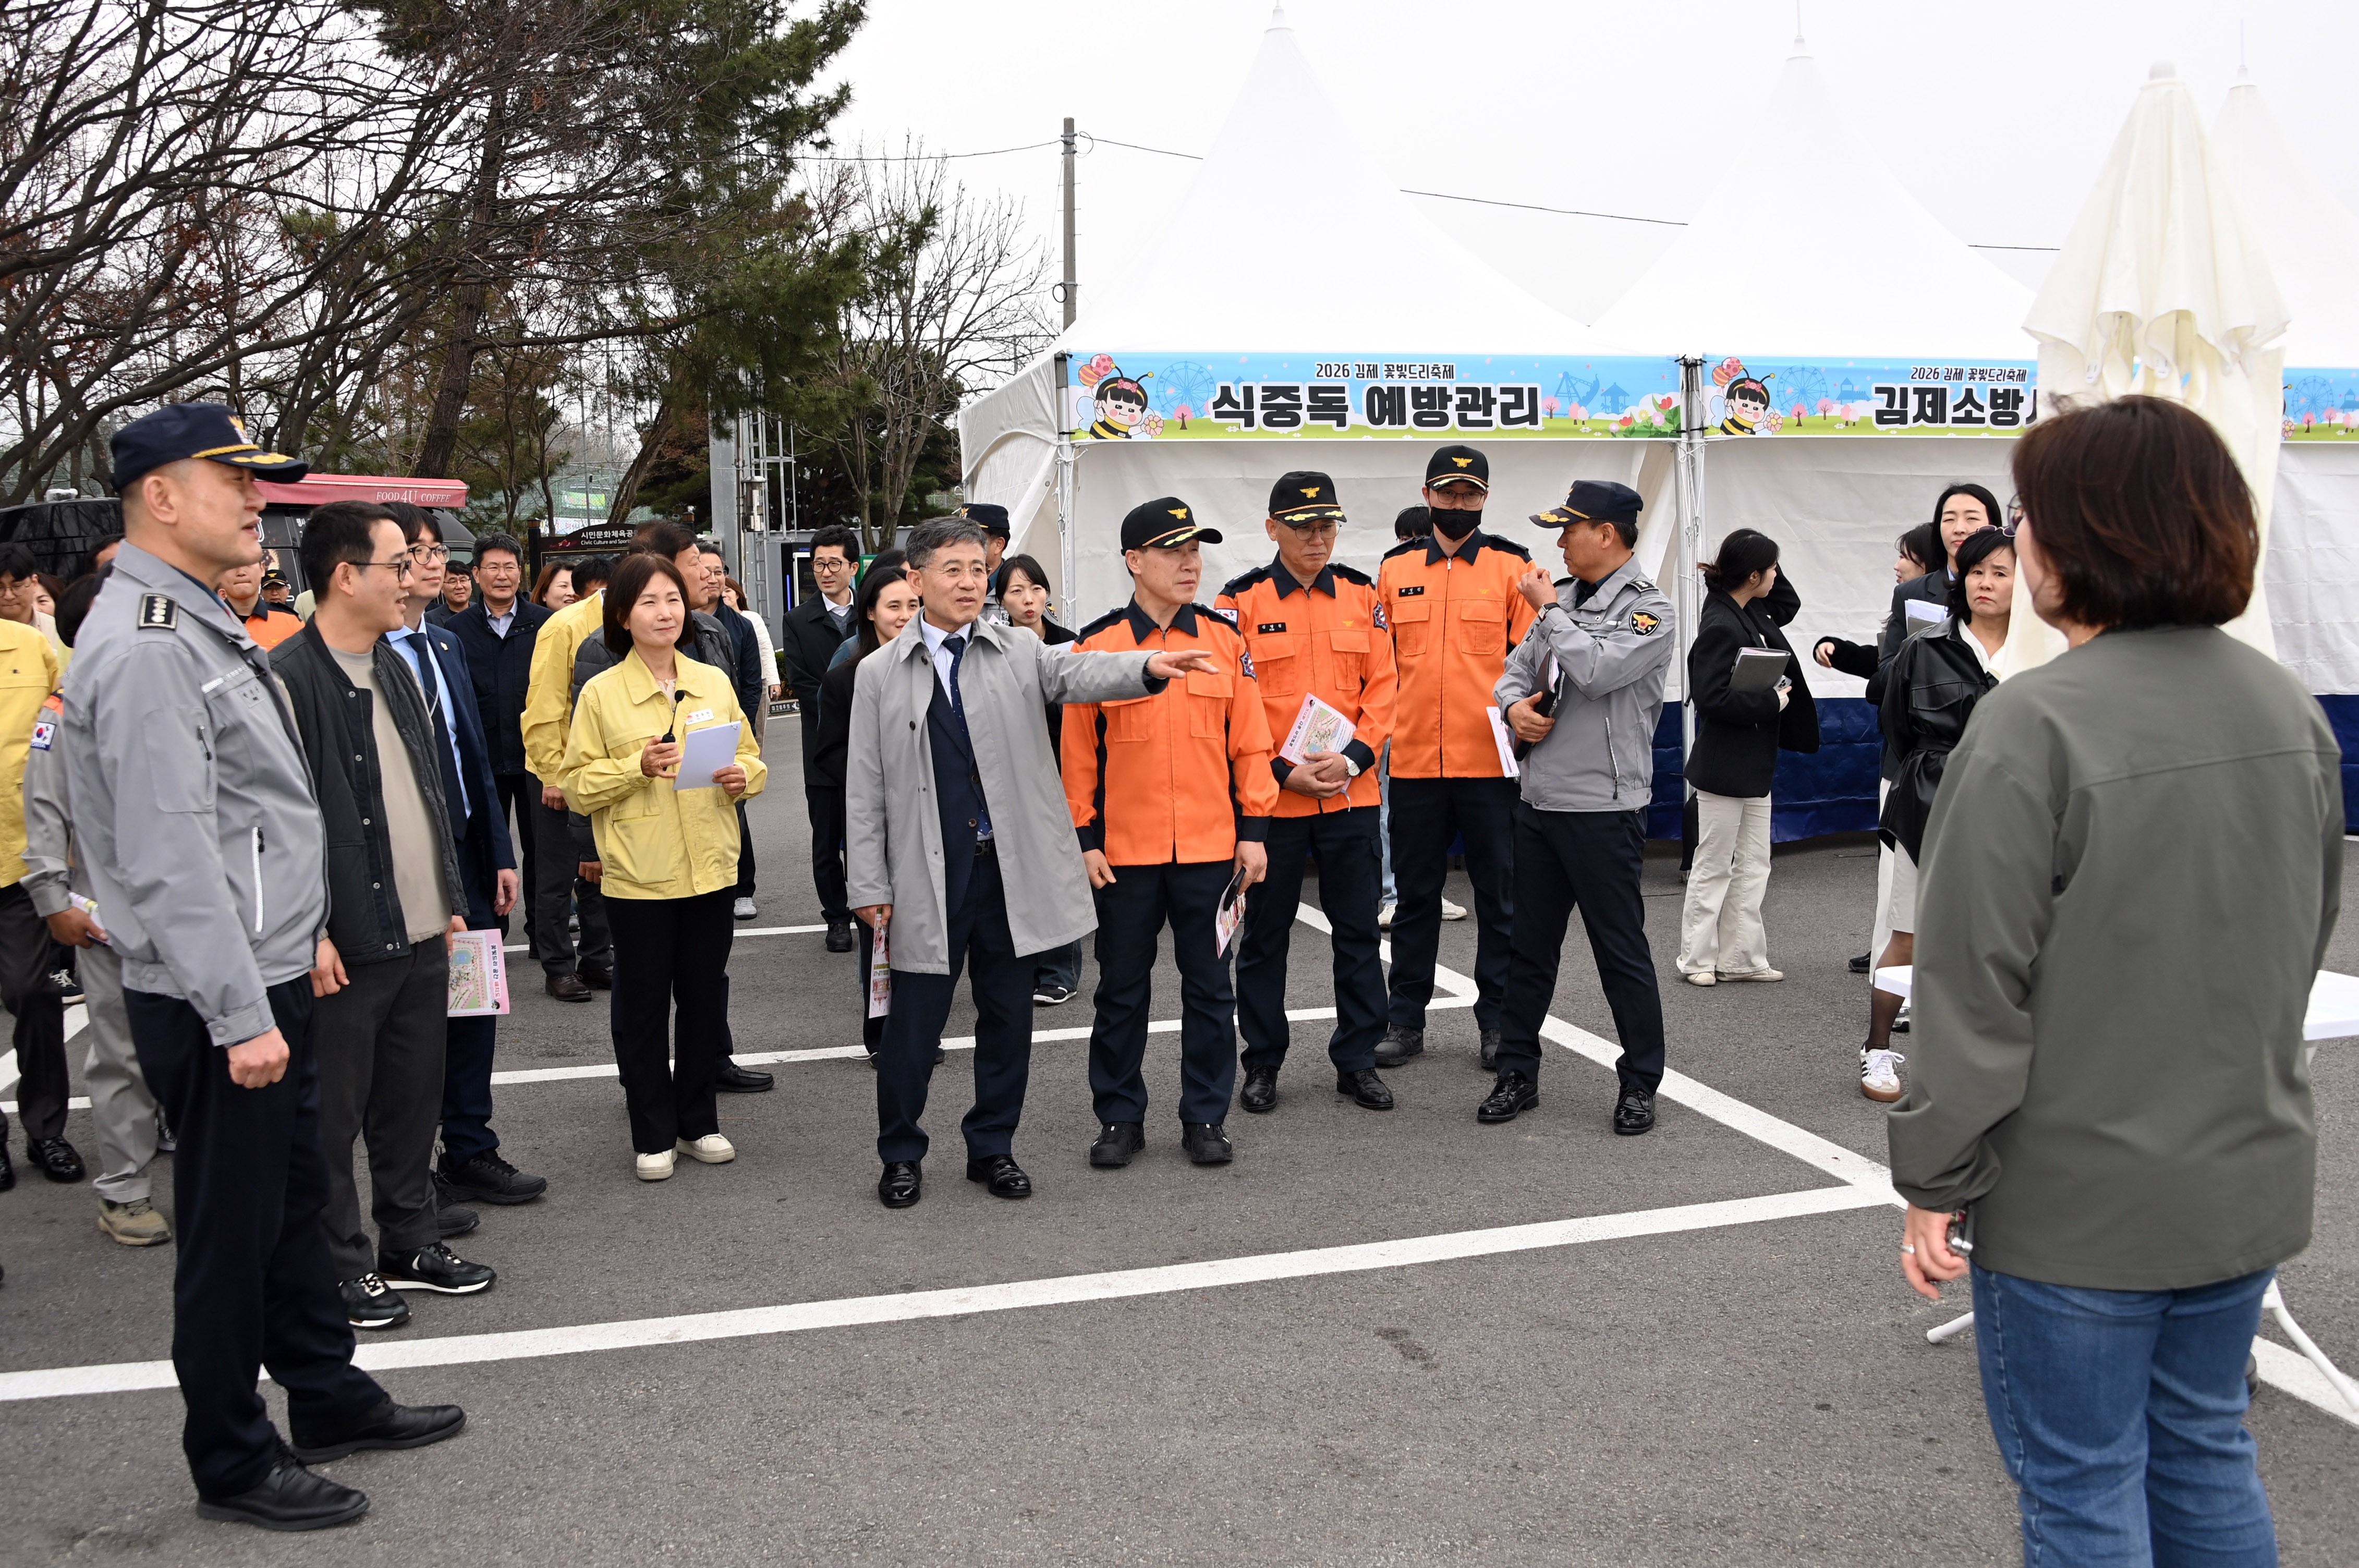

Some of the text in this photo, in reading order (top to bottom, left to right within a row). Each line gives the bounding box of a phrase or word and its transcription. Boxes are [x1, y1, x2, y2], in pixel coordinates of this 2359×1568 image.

[1317, 363, 1454, 380] 2026 김제 꽃빛드리축제
[1911, 367, 2027, 382] 2026 김제 꽃빛드리축제
[1212, 386, 1538, 428] 식중독 예방관리
[1875, 387, 2037, 426] 김제소방
[421, 493, 451, 502] COFFEE
